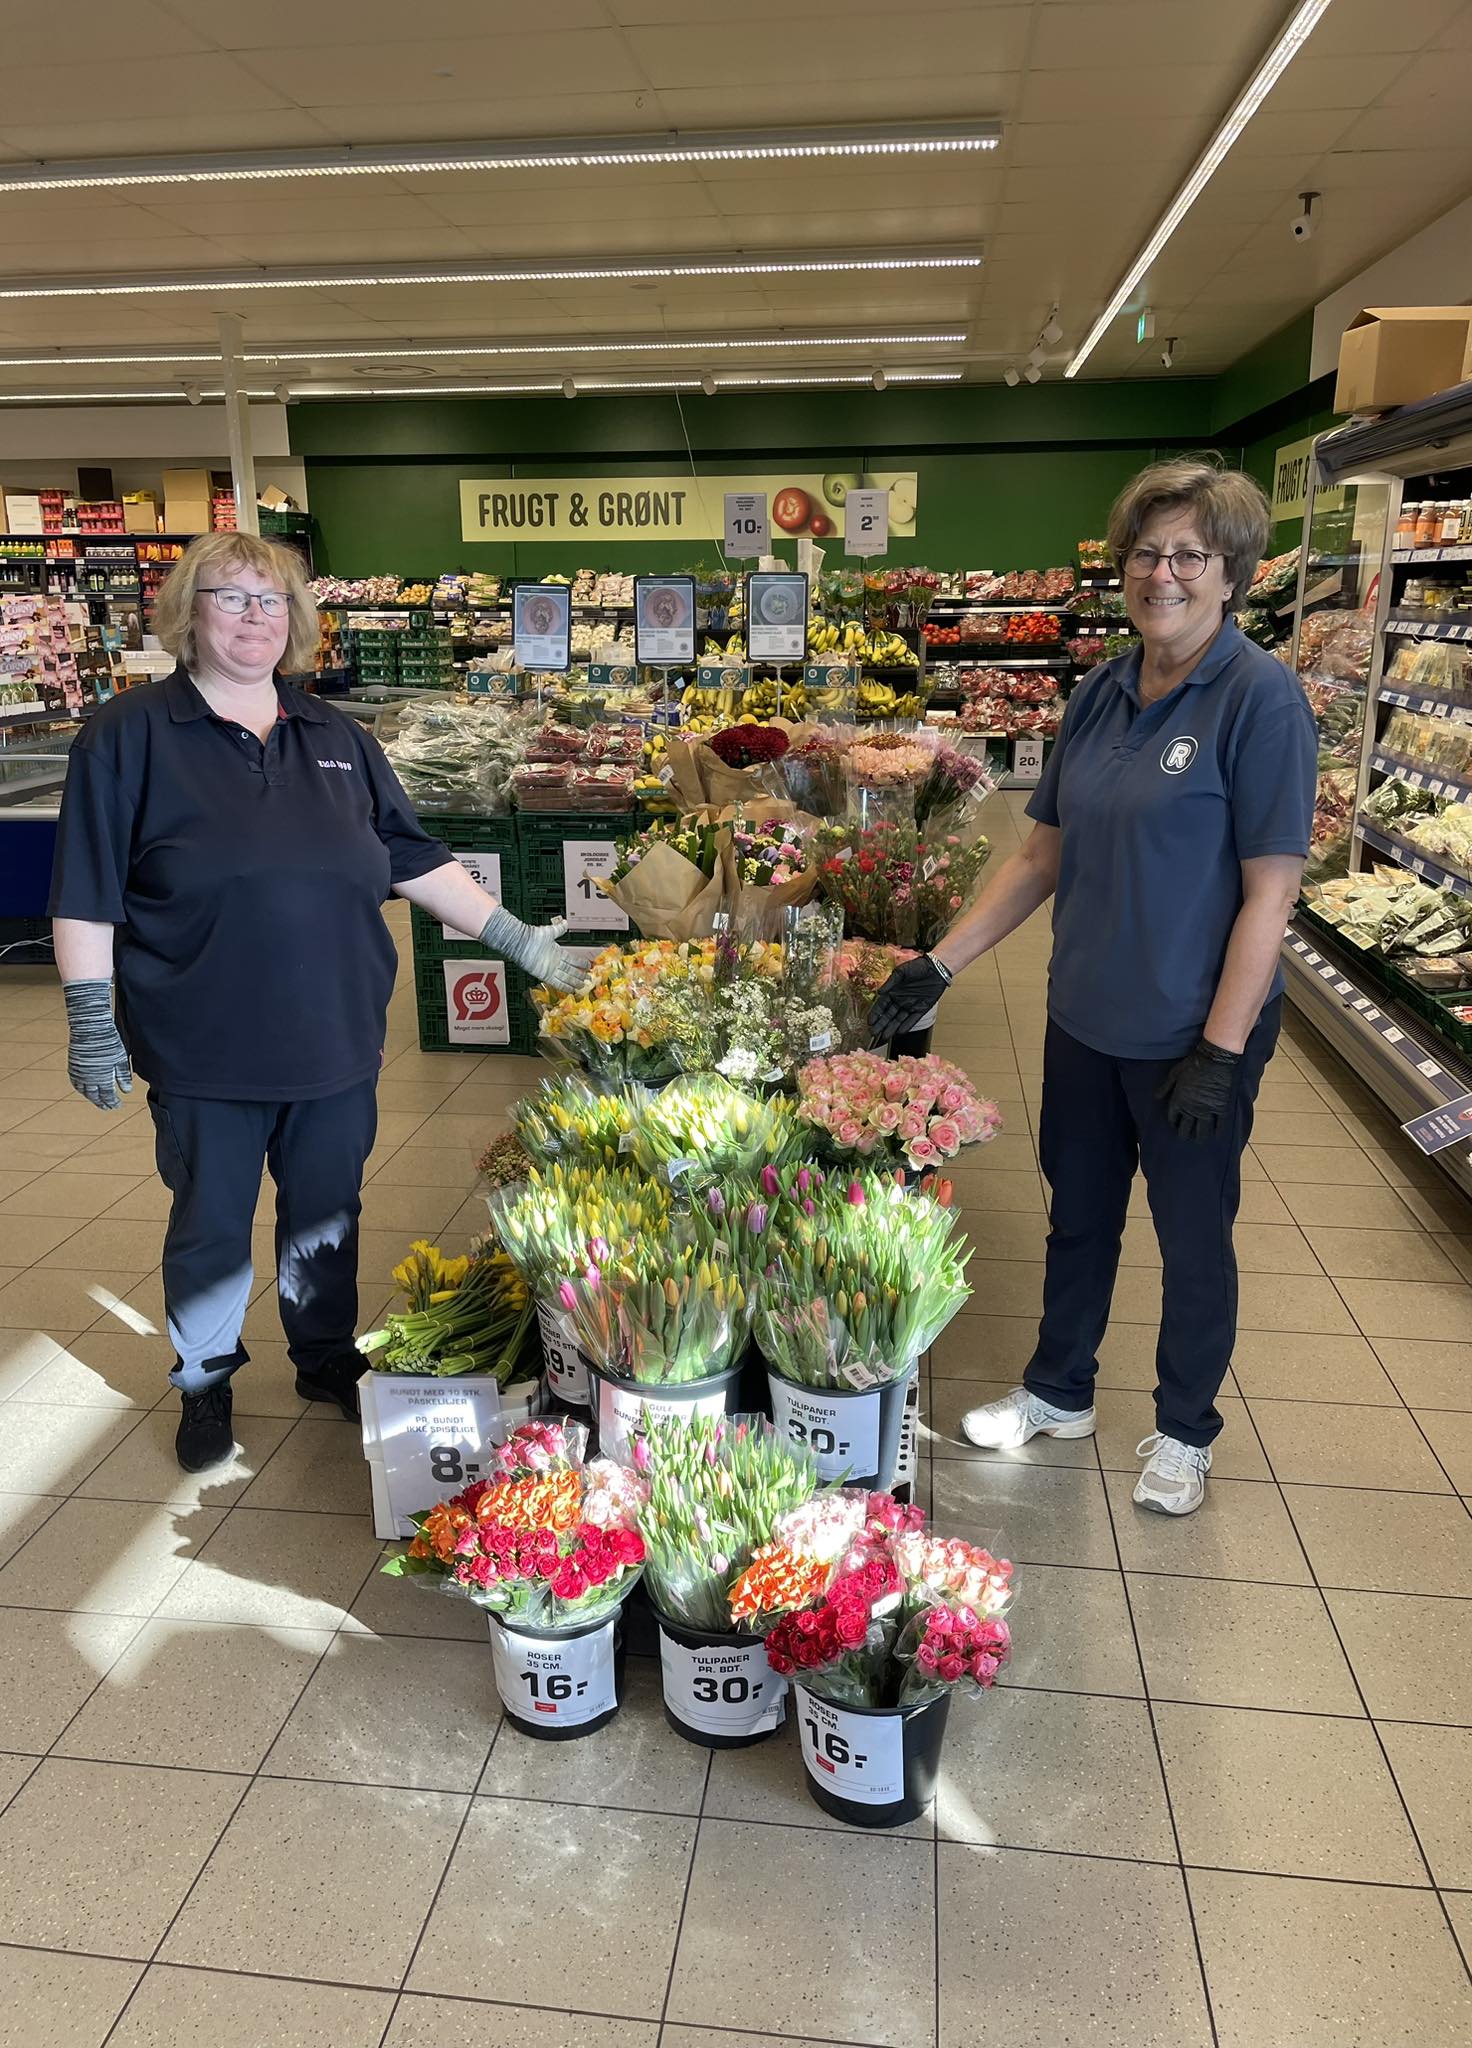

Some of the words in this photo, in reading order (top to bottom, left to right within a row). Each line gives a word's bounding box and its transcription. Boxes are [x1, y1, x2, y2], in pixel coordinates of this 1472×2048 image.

[1276, 457, 1303, 504] FRUGT
[478, 492, 559, 528] FRUGT
[568, 492, 589, 528] &
[598, 490, 686, 528] GRØNT
[389, 1388, 421, 1397] BUNDT
[423, 1388, 445, 1397] MED
[786, 1396, 837, 1417] TULIPANER
[433, 1416, 465, 1424] BUNDT
[791, 1407, 805, 1419] PR.
[808, 1414, 831, 1425] BDT.
[406, 1425, 428, 1433] IKKE
[430, 1425, 477, 1433] SPISELIGE
[527, 1651, 562, 1661] ROSER
[691, 1654, 751, 1665] TULIPANER
[526, 1659, 539, 1669] 35
[698, 1665, 716, 1674] PR.
[719, 1664, 743, 1674] BDT.
[808, 1697, 839, 1722] ROSER
[808, 1705, 819, 1720] 35
